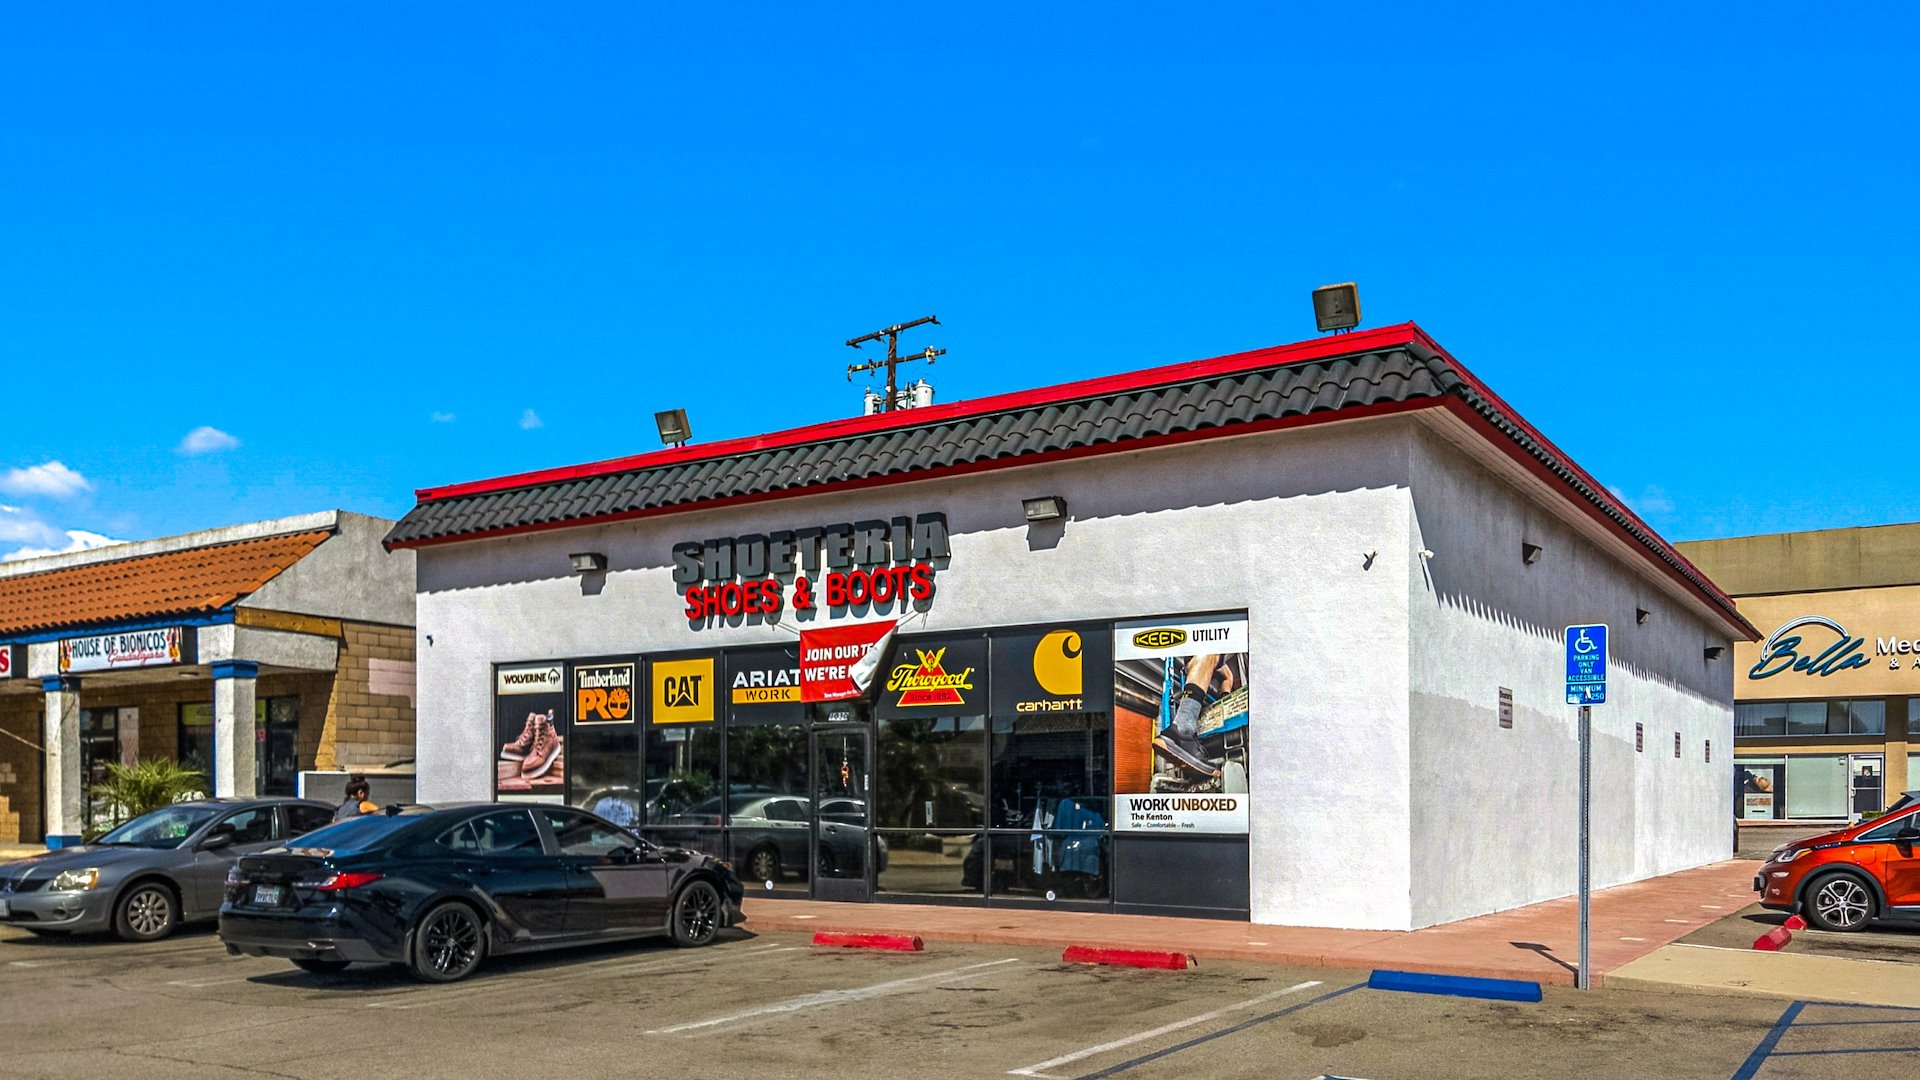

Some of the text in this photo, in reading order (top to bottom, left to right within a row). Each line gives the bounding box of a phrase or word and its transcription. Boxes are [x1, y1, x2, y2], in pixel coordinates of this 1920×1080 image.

[672, 512, 950, 583] SHOETERIA
[685, 563, 933, 620] SHOES & BOOTS
[1135, 628, 1230, 646] KEEN UTILITY
[72, 638, 101, 658] HOUSE
[104, 636, 116, 654] OF
[804, 648, 832, 662] JOIN
[835, 644, 859, 660] OUR
[107, 649, 165, 666] Guadalajara
[1749, 636, 1871, 679] Bella
[1889, 657, 1900, 670] &
[504, 672, 547, 685] WOLVERINE
[578, 668, 630, 688] Timberland
[732, 669, 800, 688] ARIAT
[804, 665, 846, 682] WE'RE
[886, 663, 974, 691] Thorogood
[664, 675, 702, 707] CAT
[745, 688, 791, 700] WORK
[578, 688, 630, 720] PRO
[1016, 698, 1082, 712] carhartt
[1130, 799, 1237, 811] WORK UNBOXED
[1146, 813, 1173, 821] Kenton
